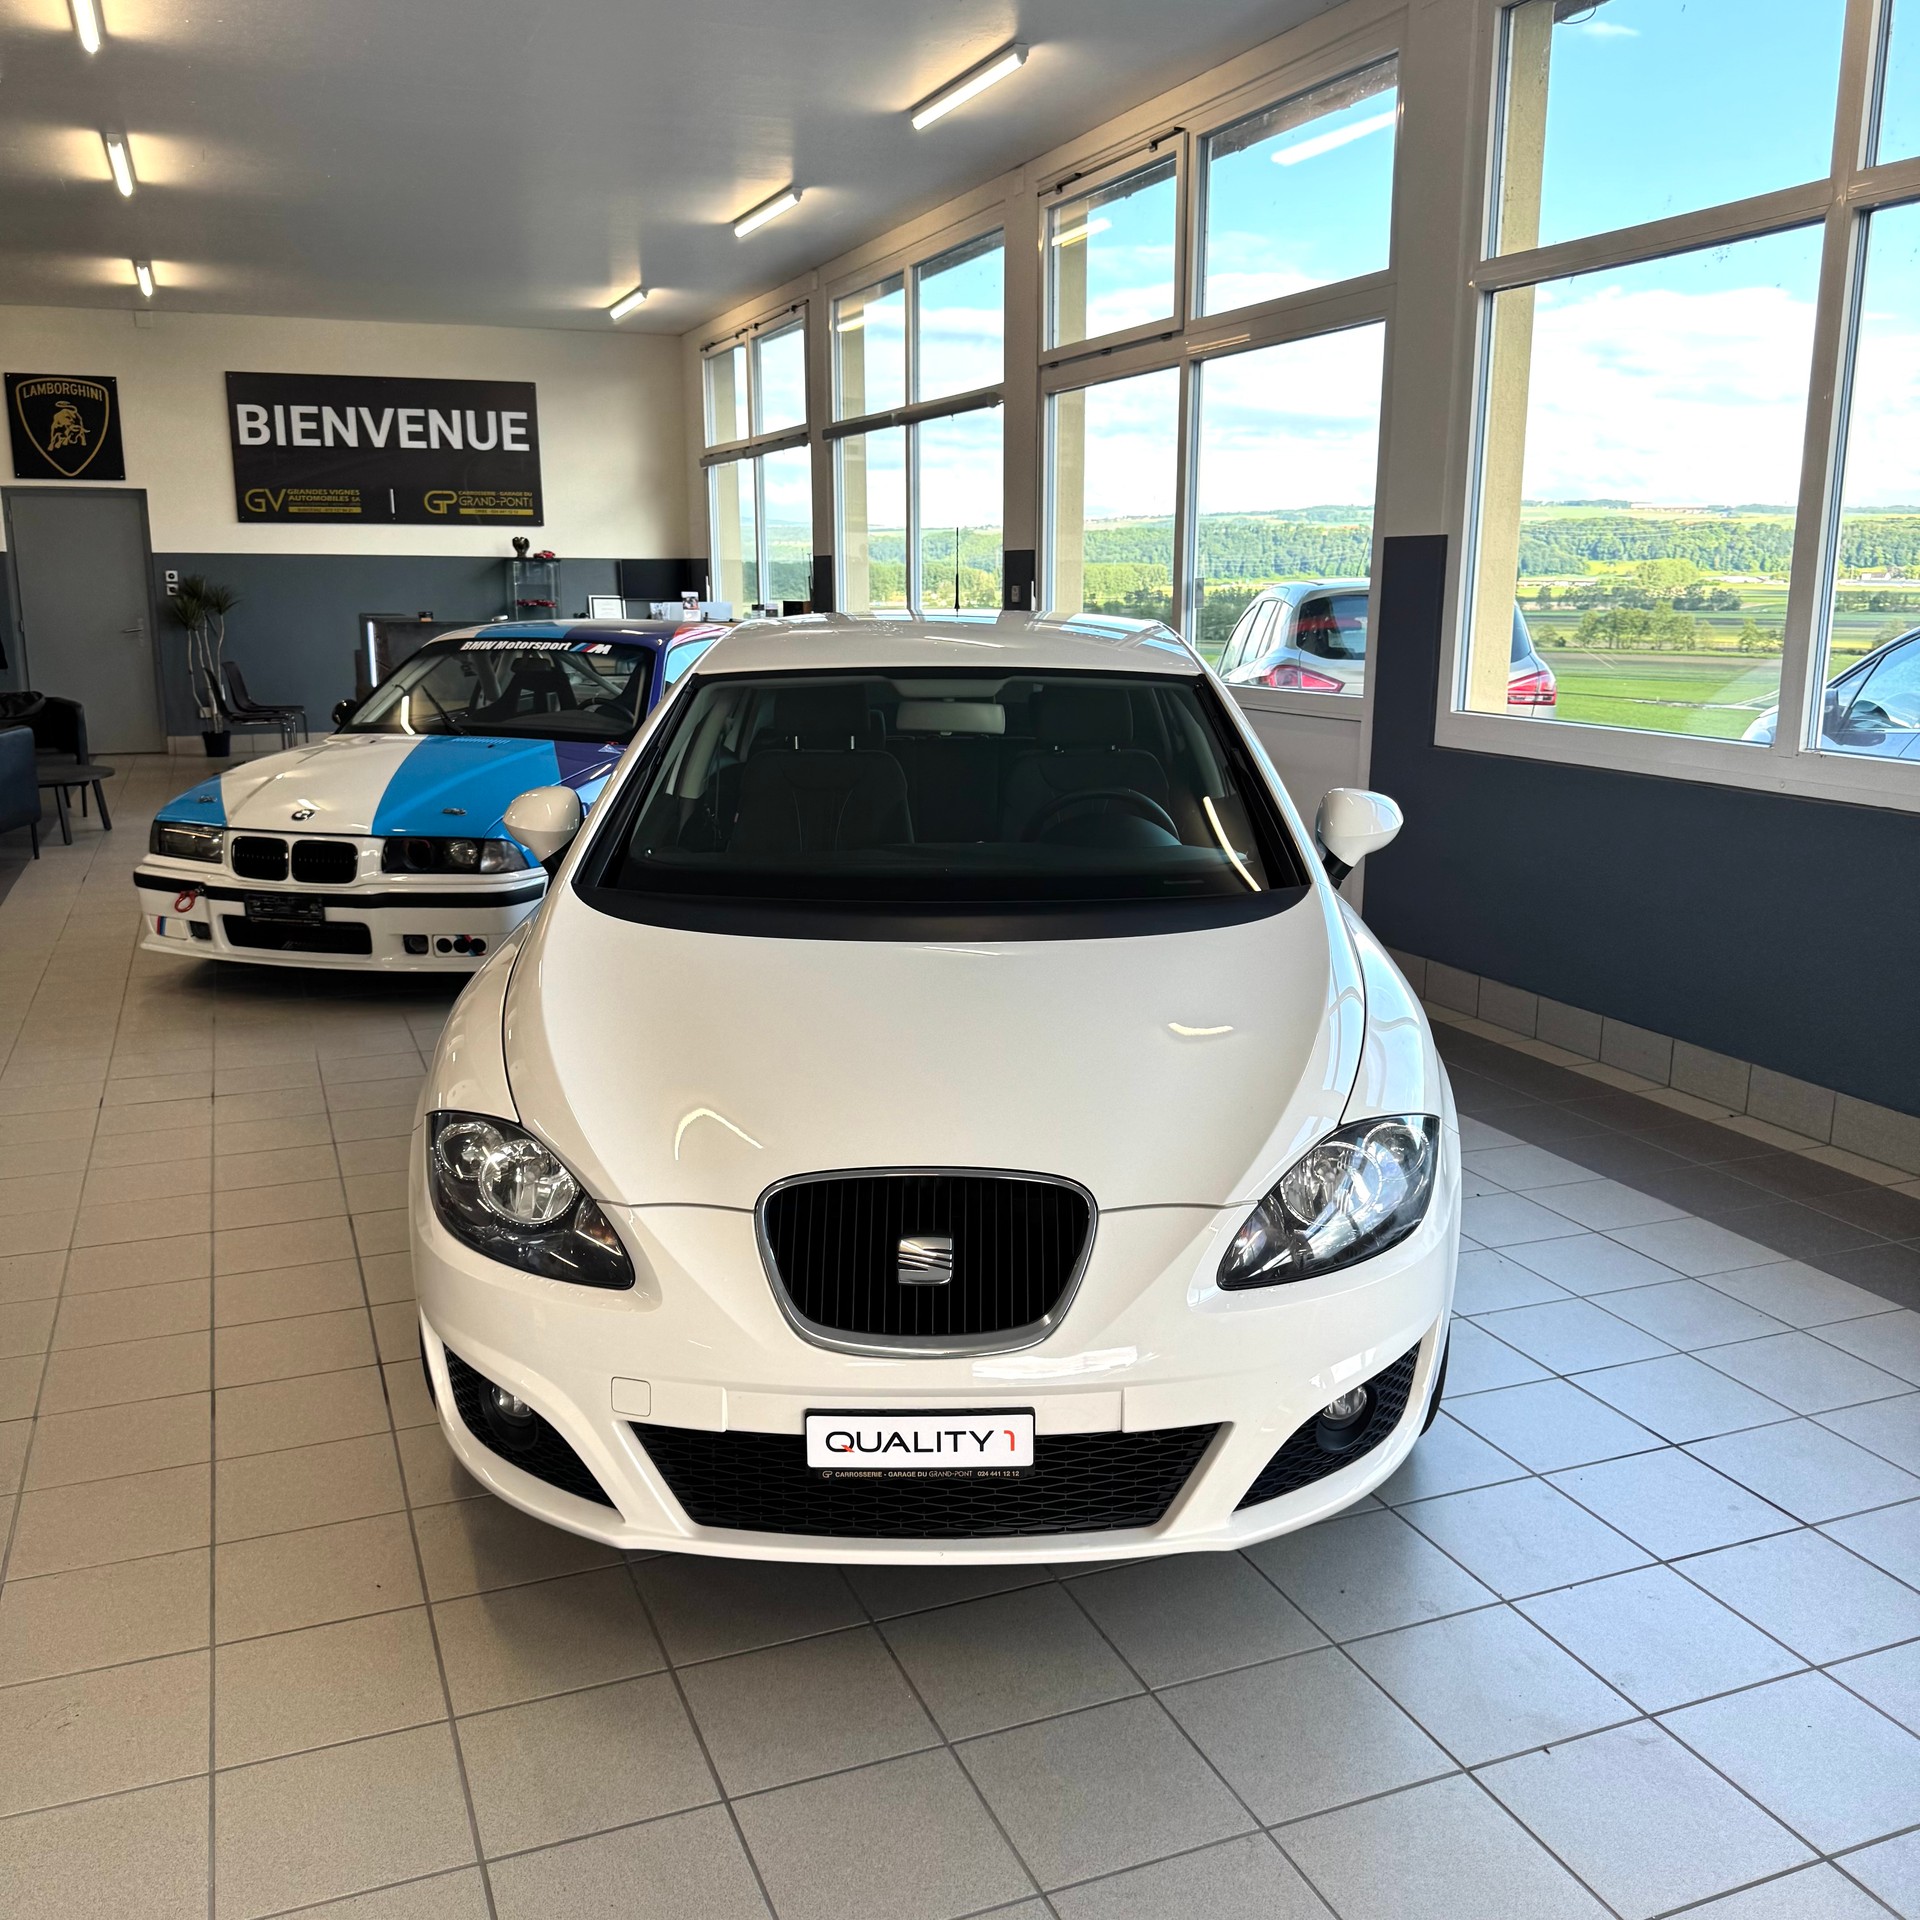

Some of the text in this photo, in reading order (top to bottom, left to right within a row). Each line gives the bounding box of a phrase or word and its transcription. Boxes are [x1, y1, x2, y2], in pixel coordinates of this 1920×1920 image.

[22, 382, 103, 402] LAMBORGHINI
[236, 403, 531, 452] BIENVENUE
[244, 488, 287, 513] GV
[287, 488, 328, 496] GRANDES
[460, 640, 498, 651] BMW
[494, 640, 573, 651] Motorsport
[825, 1429, 1016, 1453] QUALITY 1
[928, 1470, 973, 1478] GRAND-PONT
